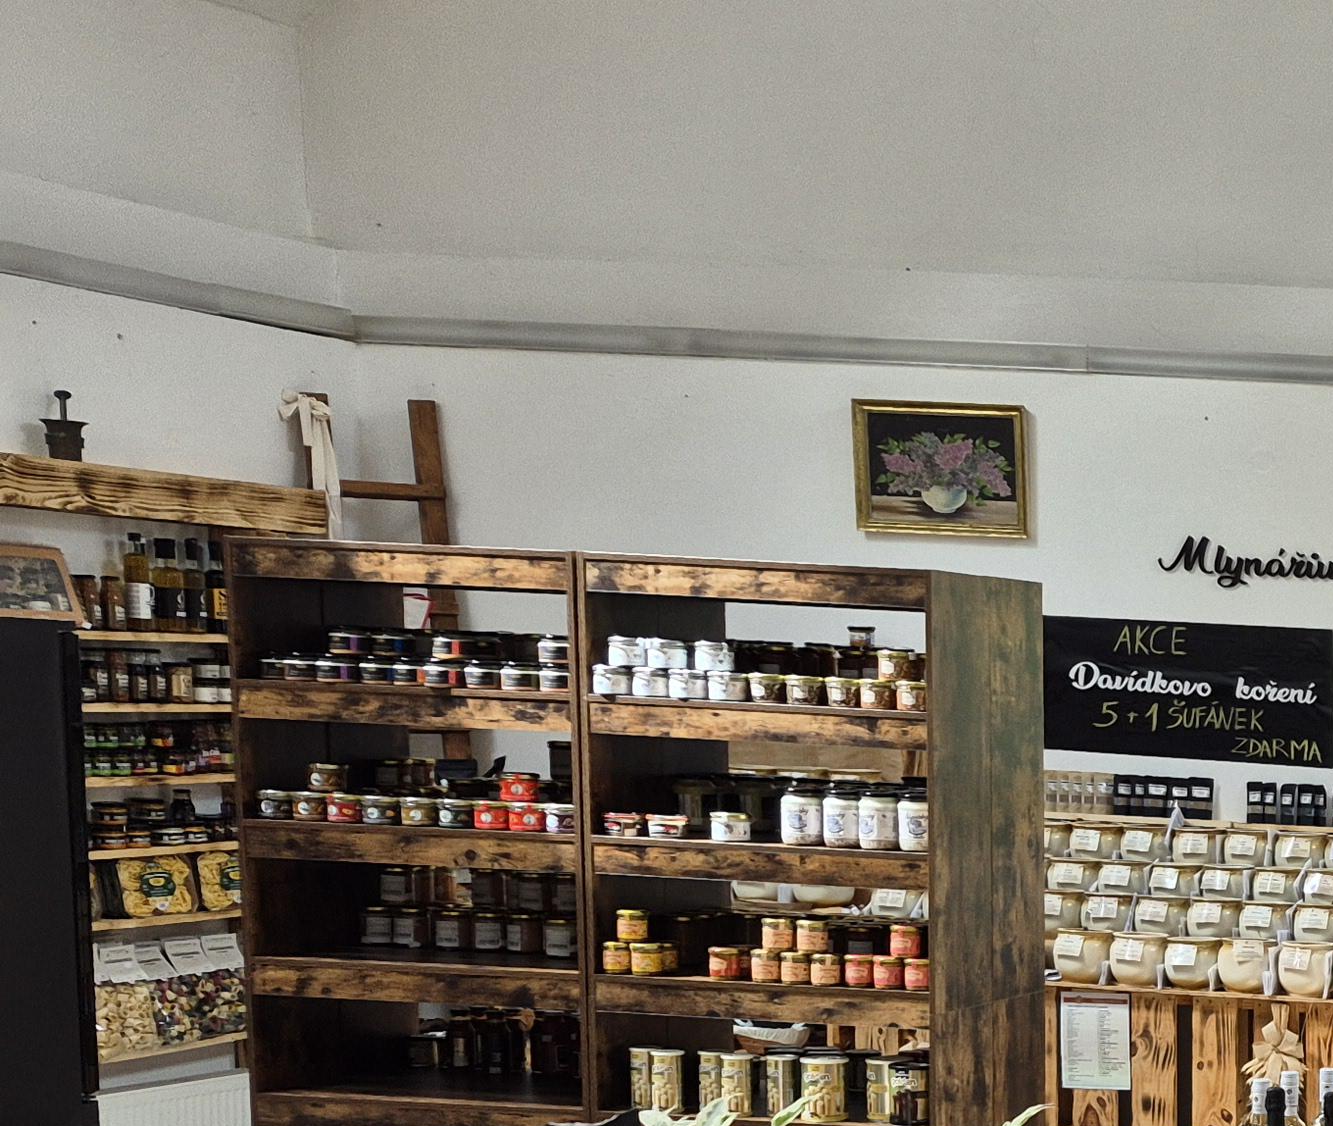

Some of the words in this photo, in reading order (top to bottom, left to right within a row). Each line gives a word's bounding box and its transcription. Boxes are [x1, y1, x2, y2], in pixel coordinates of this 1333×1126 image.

[1113, 625, 1188, 655] AKCE
[1068, 661, 1213, 697] Davídkovo
[1234, 675, 1318, 705] koření
[1165, 698, 1265, 732] ŠUFÁNEK
[1230, 736, 1323, 764] ZDARMA
